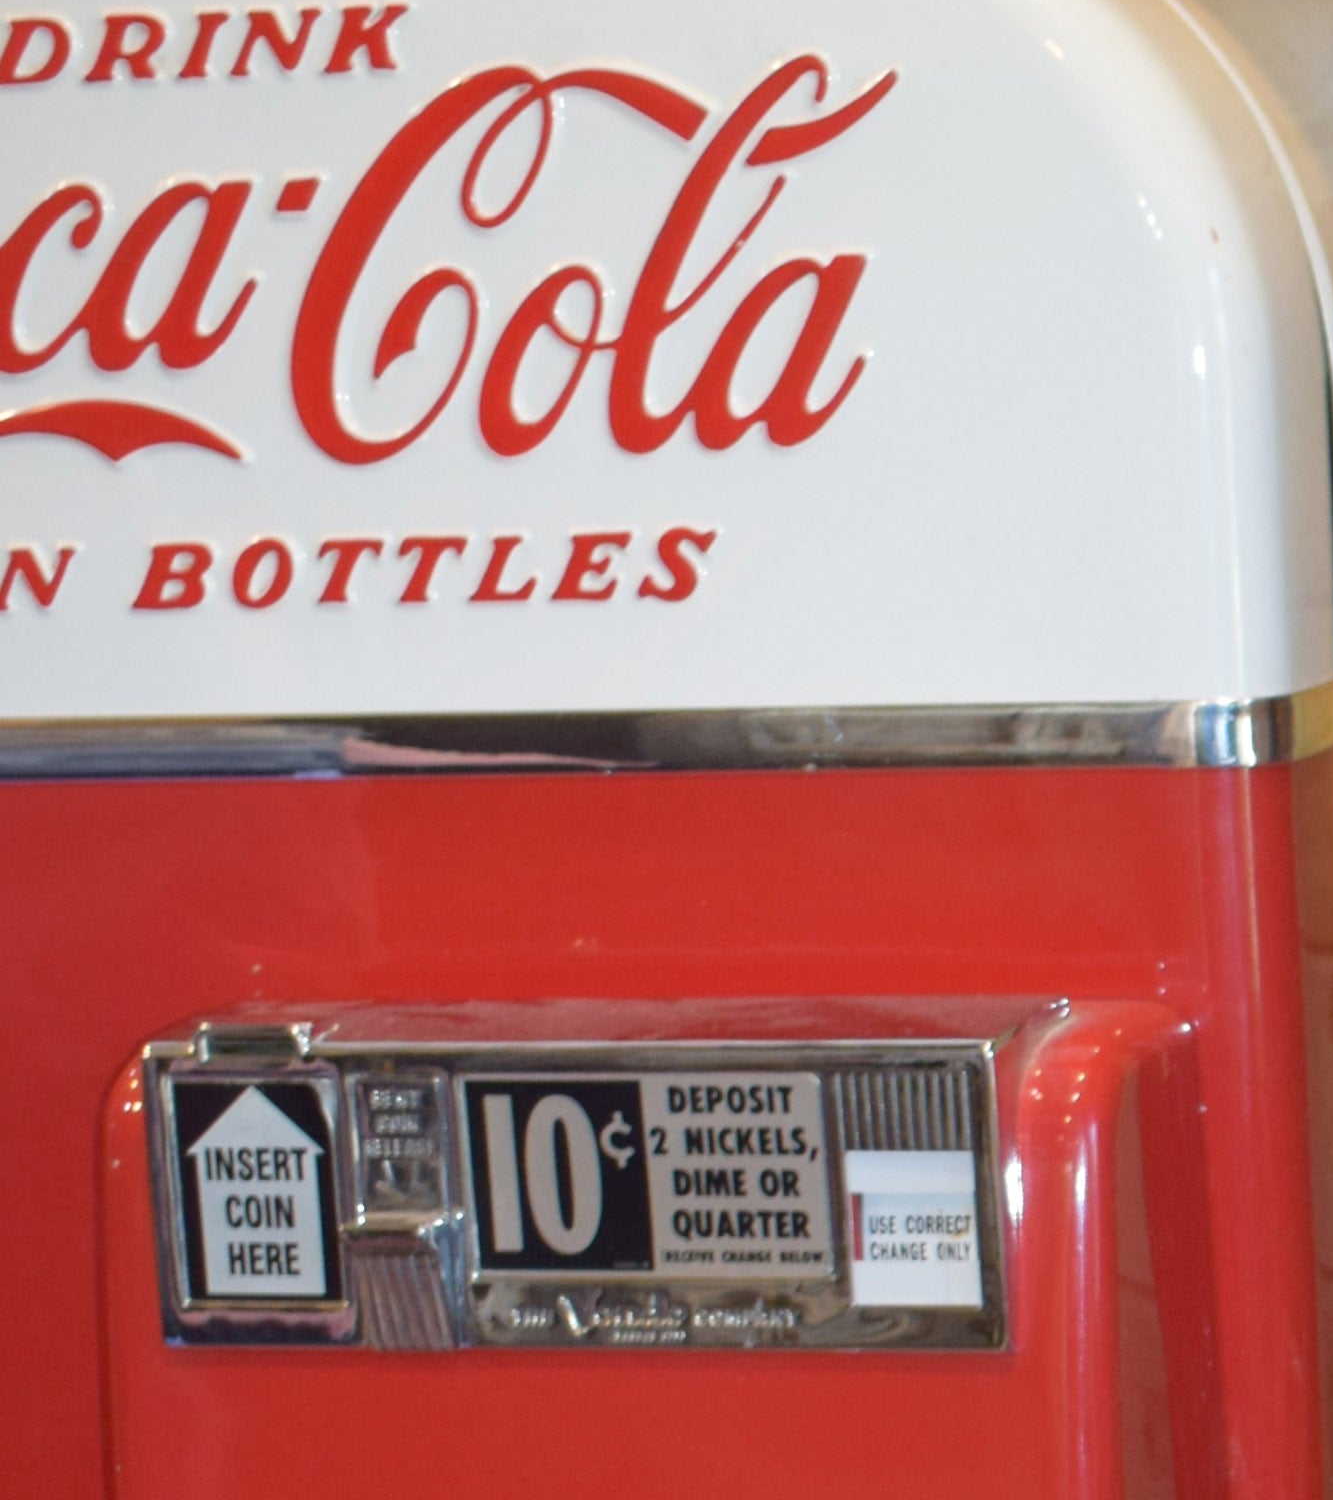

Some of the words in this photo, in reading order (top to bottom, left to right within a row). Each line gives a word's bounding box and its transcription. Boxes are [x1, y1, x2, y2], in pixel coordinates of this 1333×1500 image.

[0, 3, 409, 86] DRINK
[0, 55, 898, 465] ca-Cola
[0, 546, 75, 612] N
[133, 526, 719, 611] BOTTLES
[667, 1085, 793, 1115] DEPOSIT
[650, 1127, 668, 1155] 2
[685, 1127, 820, 1161] NICKELS,
[204, 1146, 308, 1181] INSERT
[672, 1169, 747, 1198] DIME
[760, 1169, 800, 1197] OR
[225, 1194, 295, 1228] COIN
[672, 1210, 811, 1241] QUARTER
[869, 1215, 897, 1235] USE
[905, 1214, 972, 1235] CORRECT
[228, 1243, 302, 1276] HERE
[870, 1241, 928, 1261] CHANGE
[936, 1241, 972, 1261] ONLY
